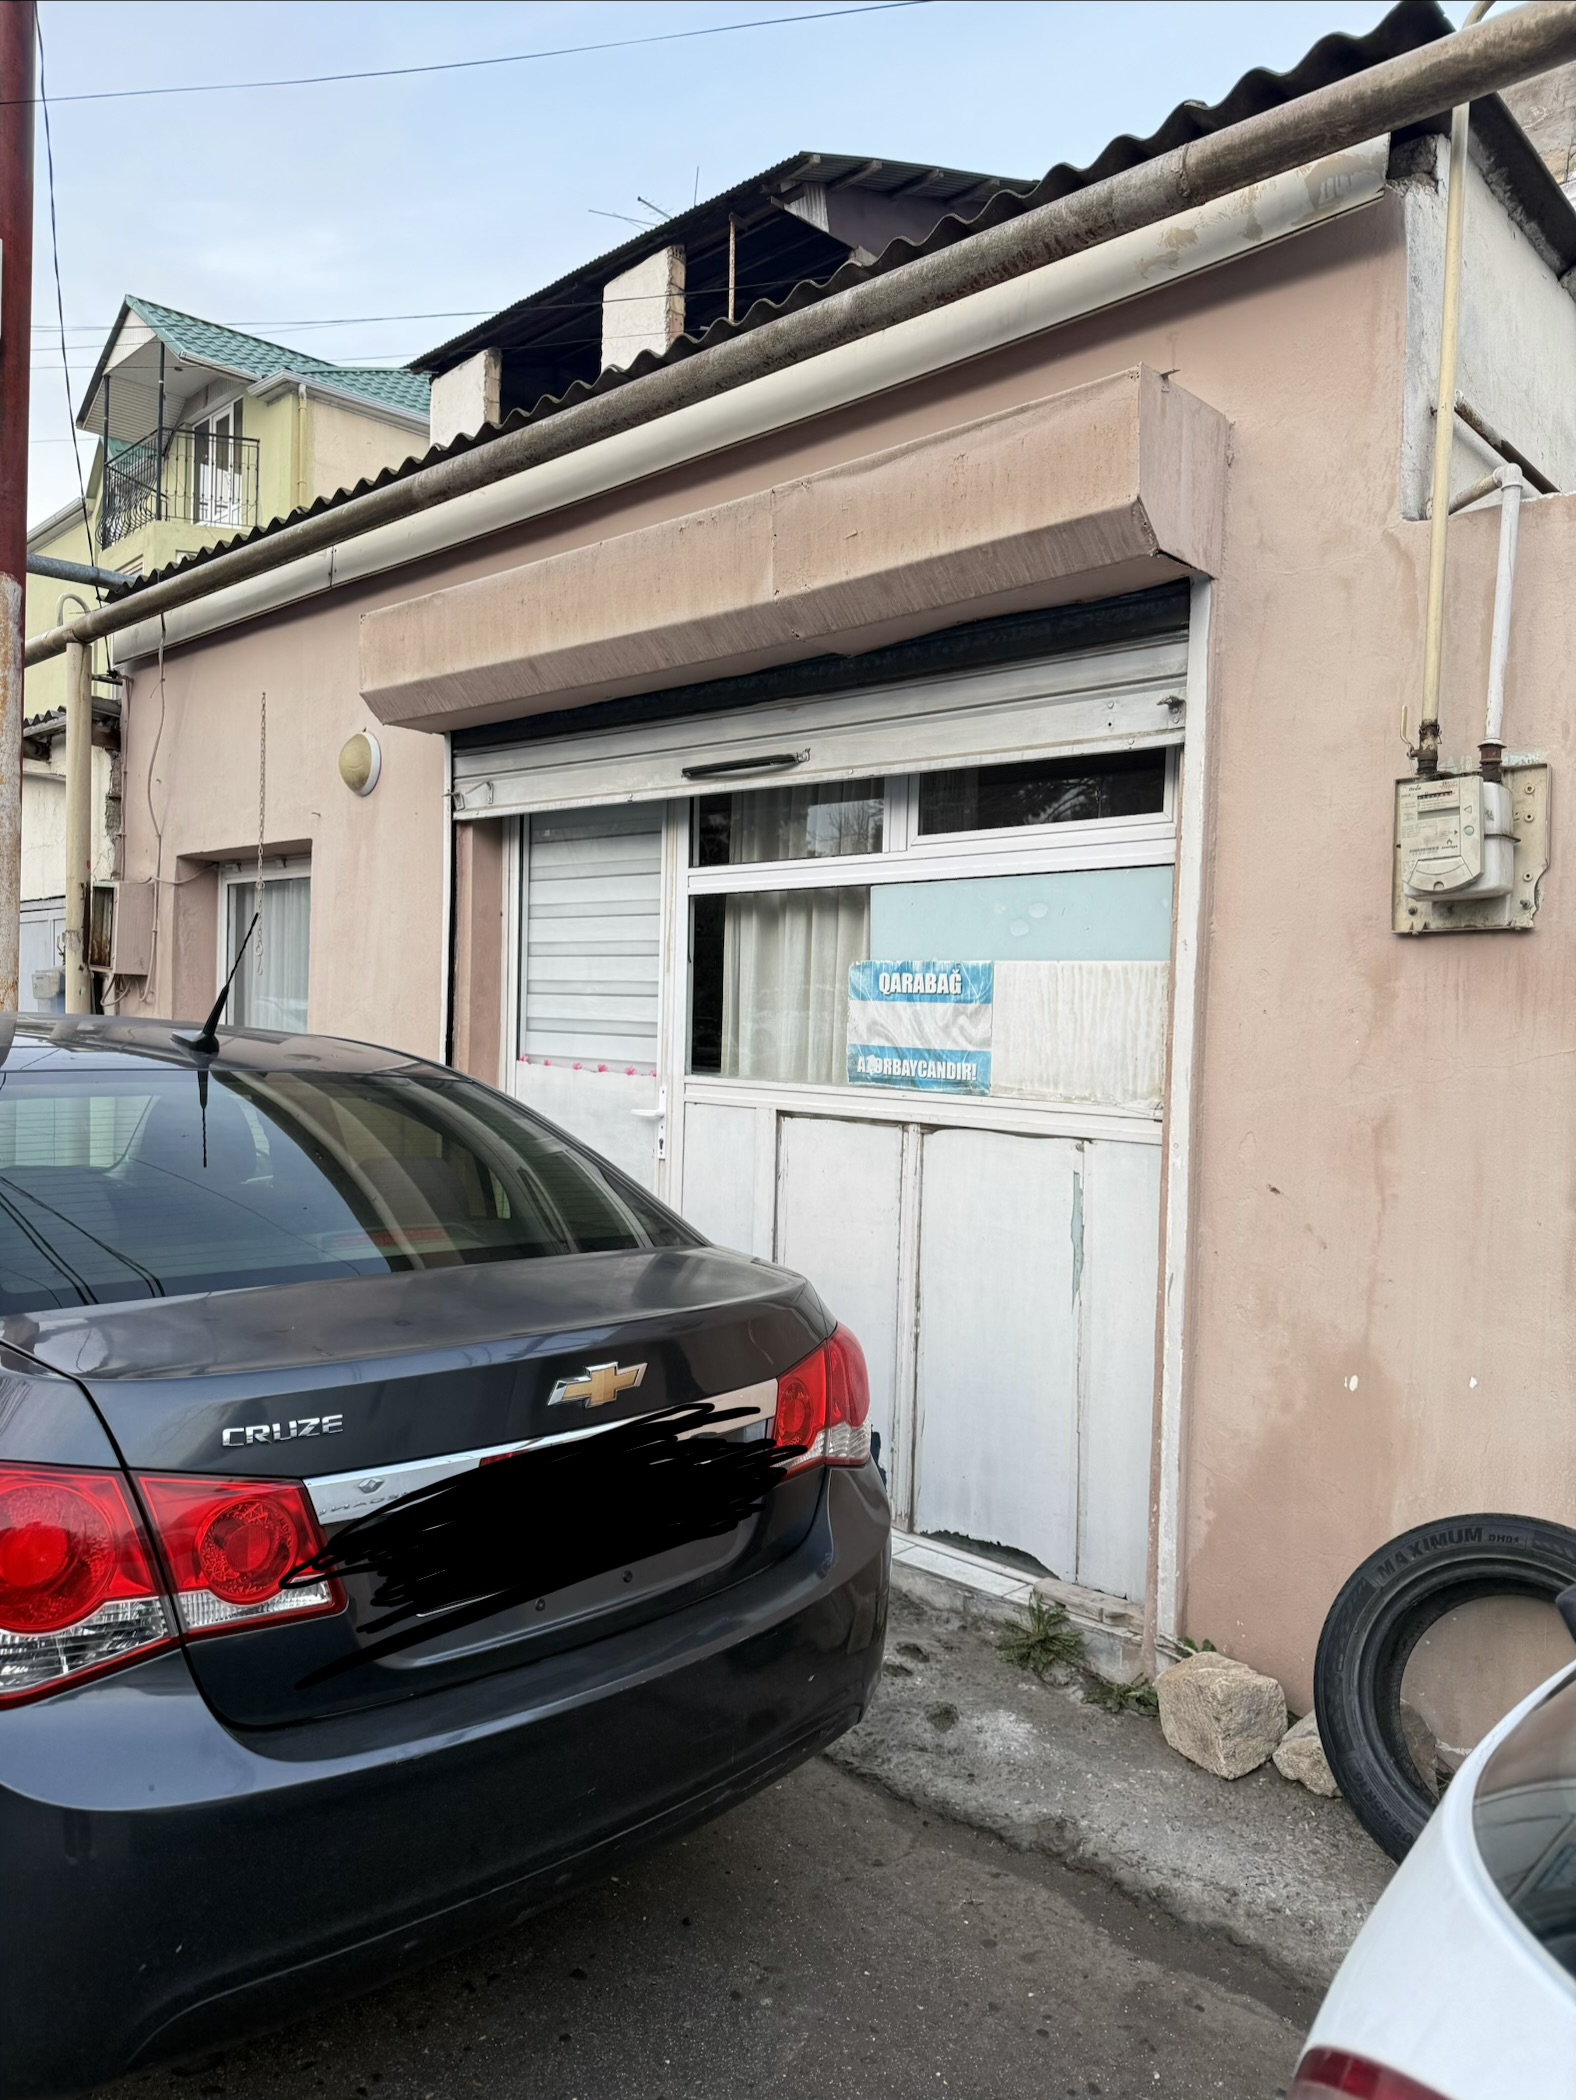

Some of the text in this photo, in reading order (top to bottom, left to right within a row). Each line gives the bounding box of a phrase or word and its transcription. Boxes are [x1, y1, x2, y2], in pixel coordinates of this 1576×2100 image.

[879, 969, 962, 994] QARABAĞ
[222, 1414, 343, 1446] CRUZE
[1376, 1528, 1482, 1578] MAXIMUM
